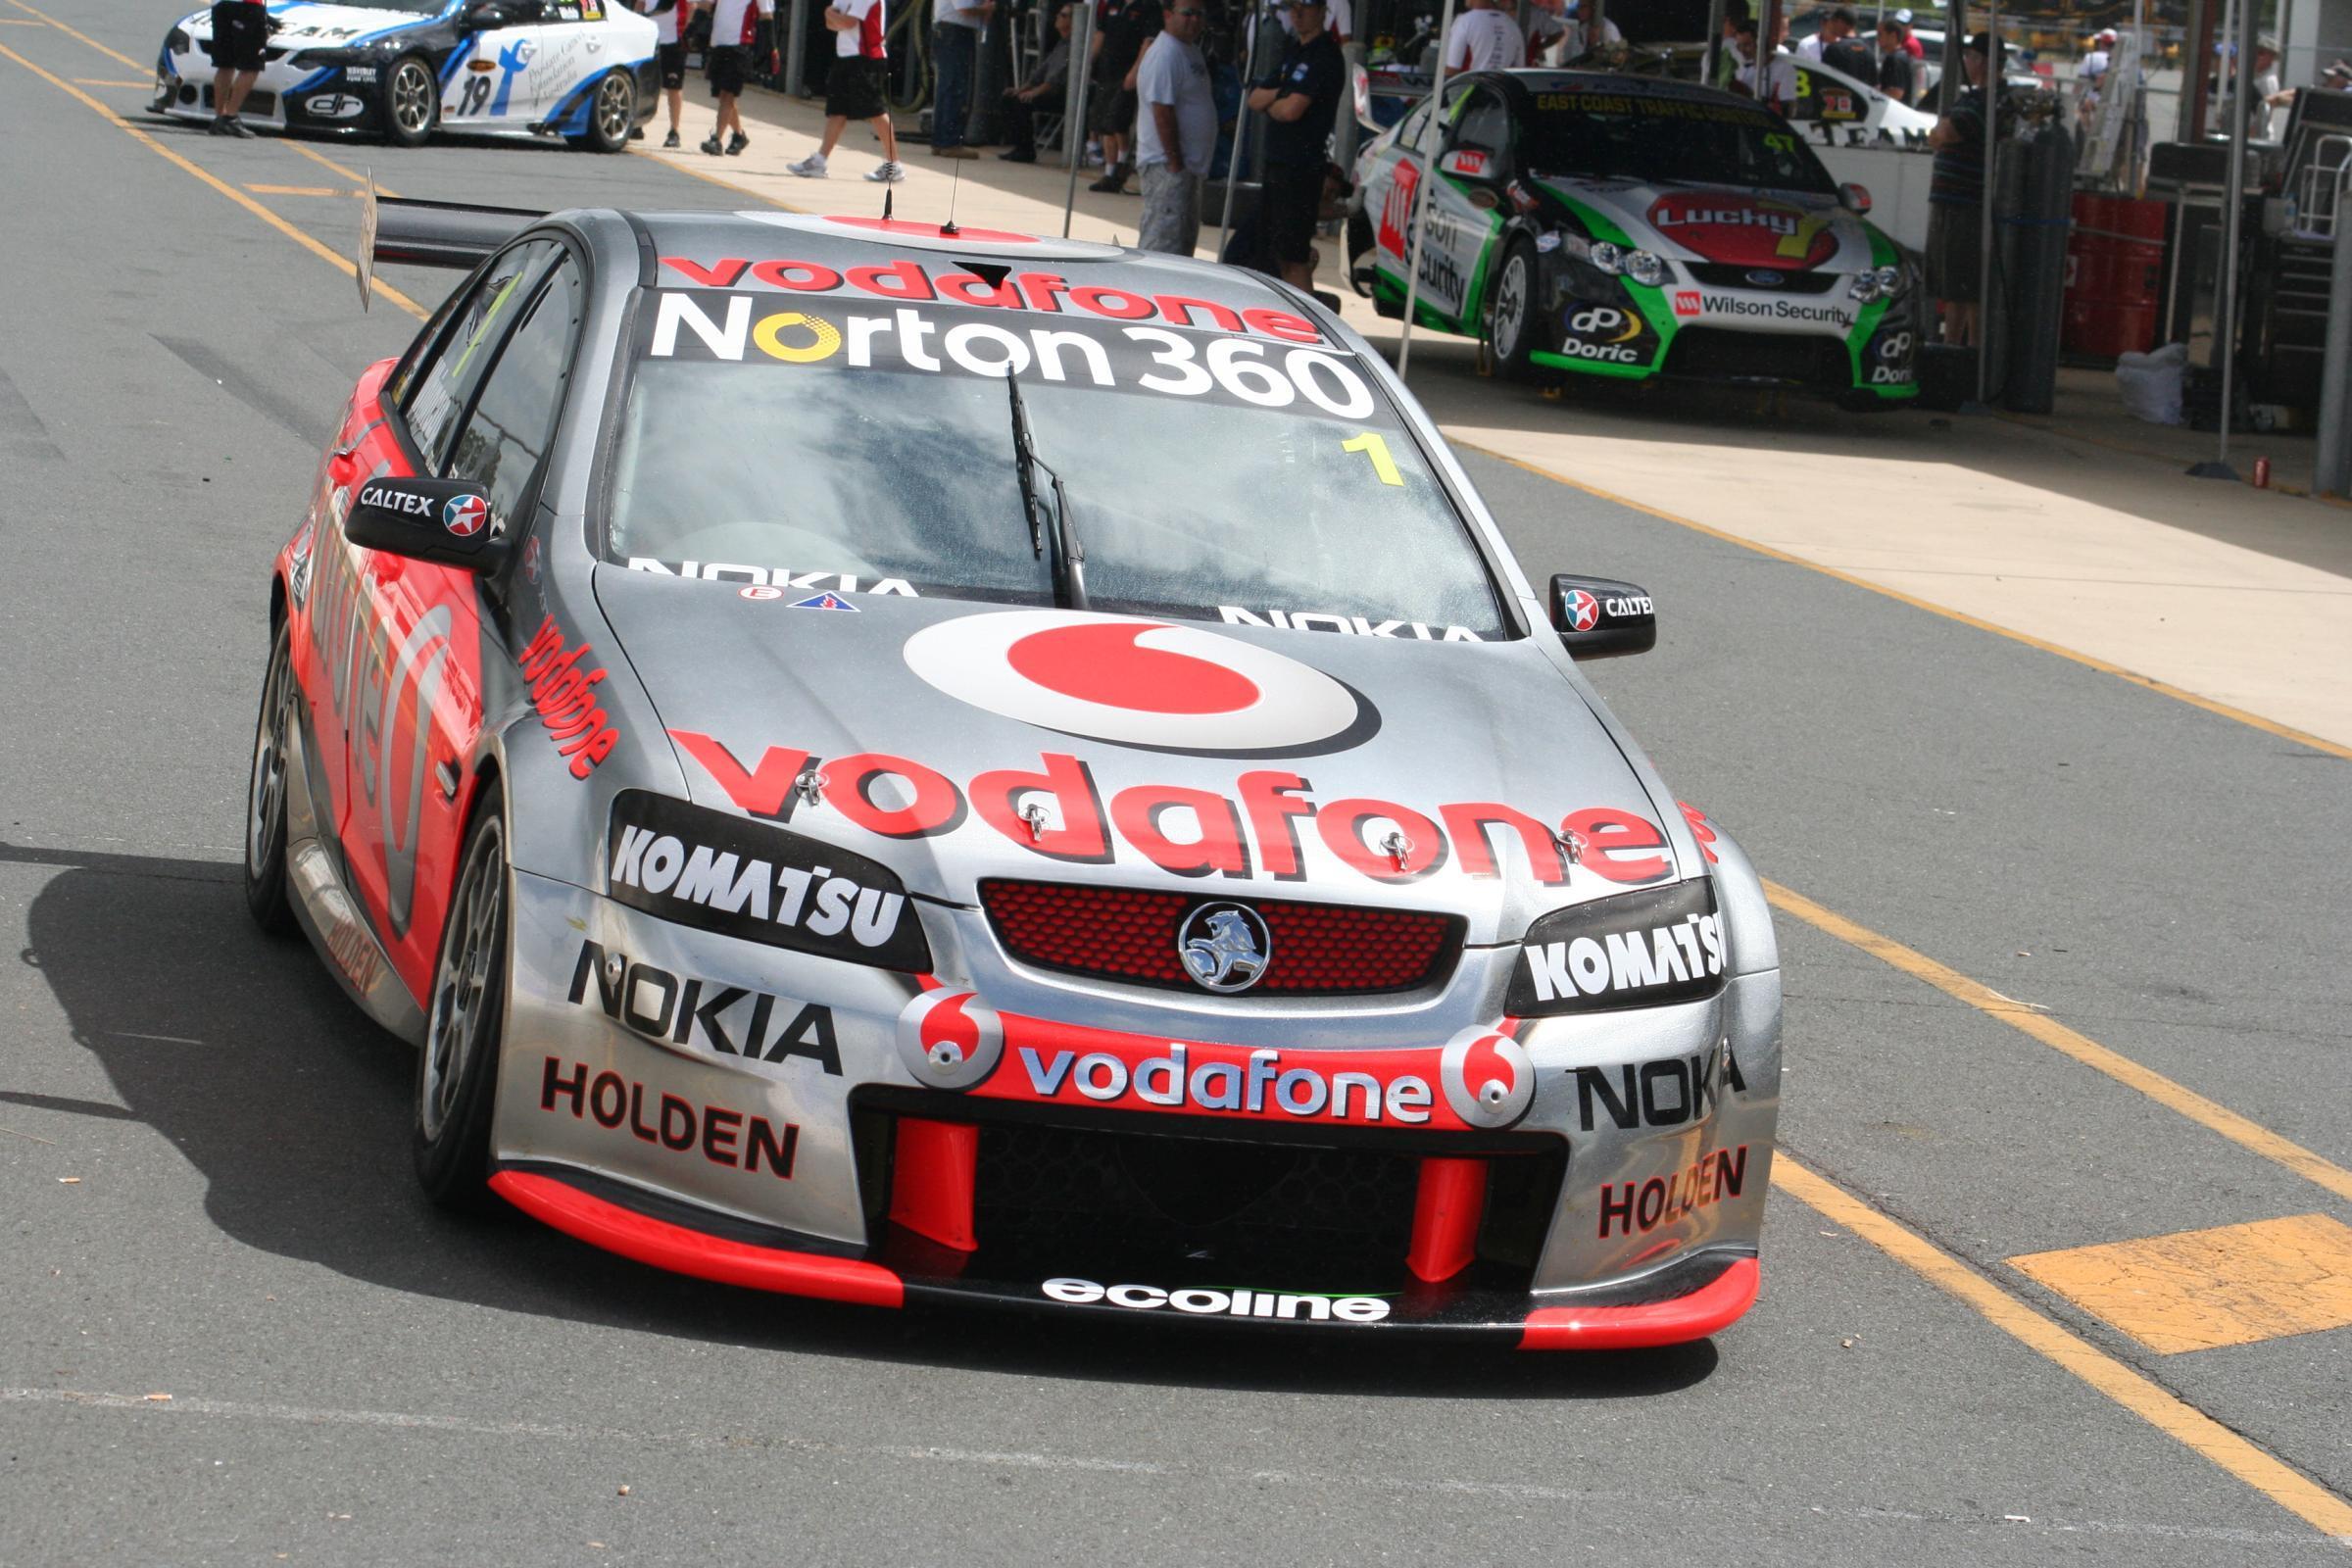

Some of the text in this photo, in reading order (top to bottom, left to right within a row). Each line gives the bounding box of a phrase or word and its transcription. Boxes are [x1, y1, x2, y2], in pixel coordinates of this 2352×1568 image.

[457, 75, 491, 116] 19
[1537, 94, 1577, 111] EAST
[1581, 95, 1634, 114] COAST
[659, 257, 1323, 343] vodafone
[1703, 296, 1853, 327] Wilson Security
[651, 293, 1374, 419] Norton 360
[1562, 337, 1638, 363] Doric
[1341, 431, 1404, 487] 1
[361, 487, 435, 517] CALTEX
[518, 612, 620, 781] vodafone
[666, 727, 1675, 887] vodafone
[612, 824, 905, 948] KOMATSU
[567, 939, 844, 1077] NOKIA
[540, 1055, 801, 1181] HOLDEN
[1018, 1044, 1435, 1124] vodafone
[1598, 1145, 1748, 1240] HOLDEN
[1041, 1277, 1392, 1323] ecoline
